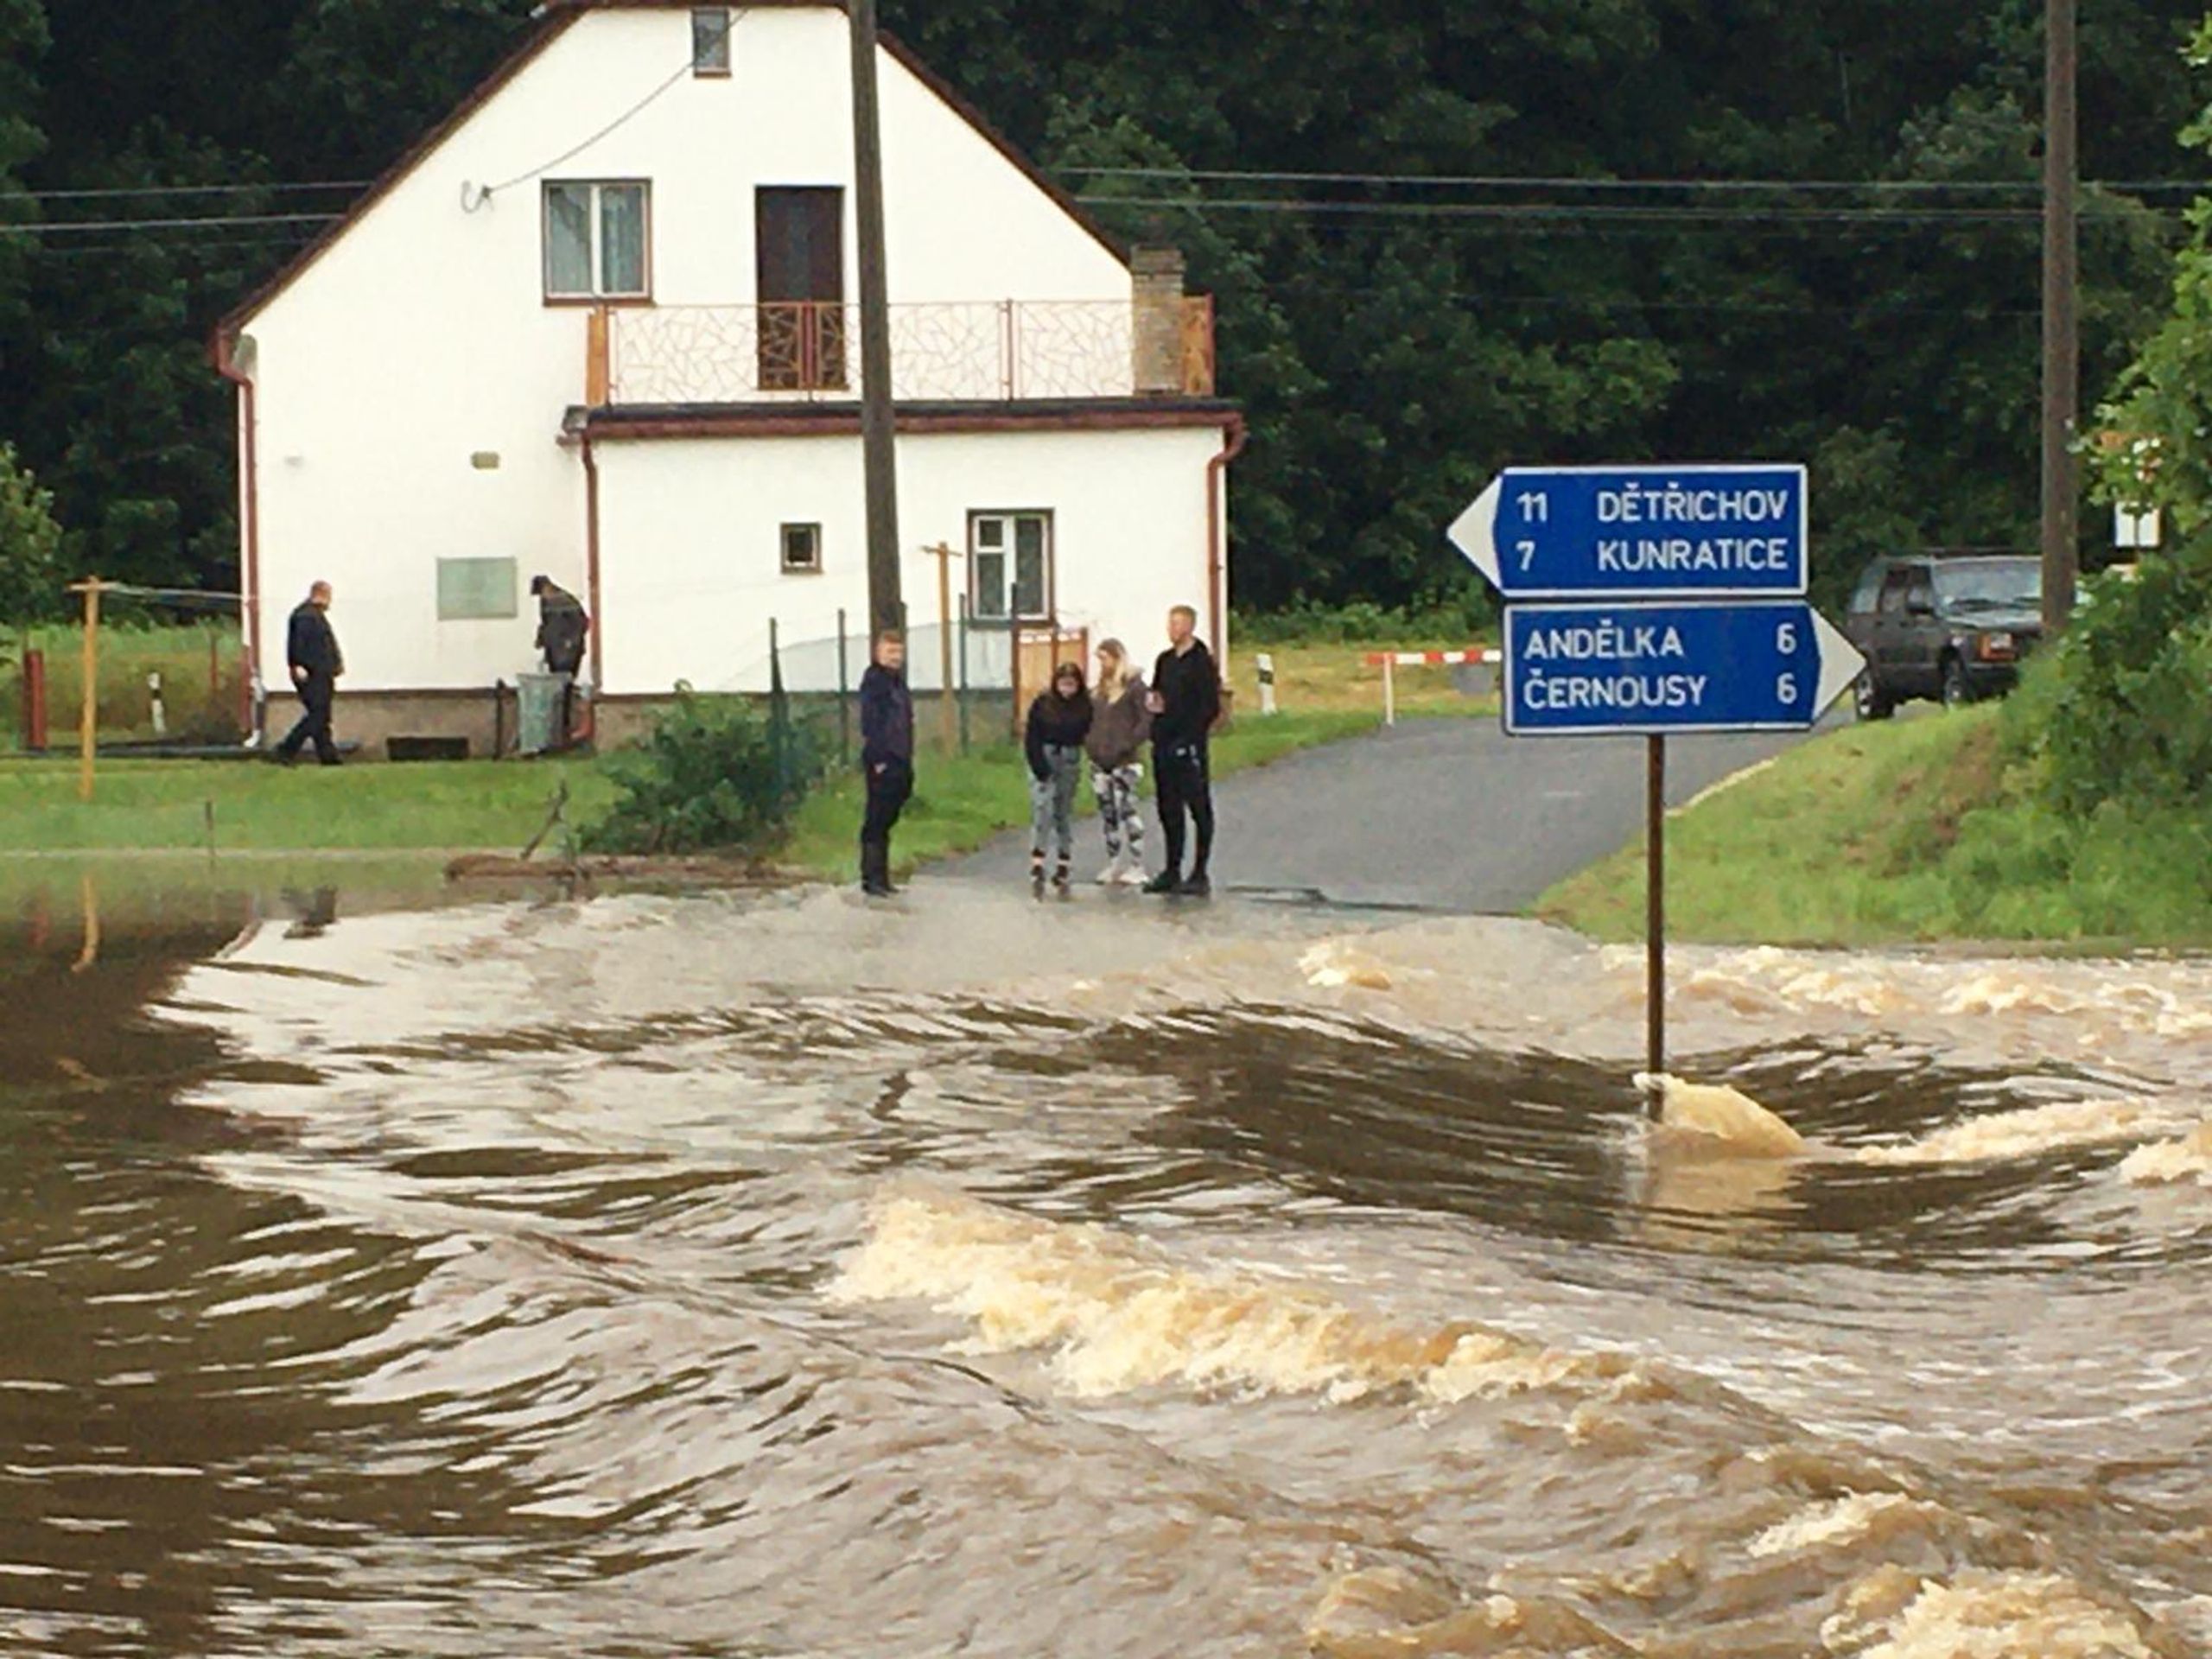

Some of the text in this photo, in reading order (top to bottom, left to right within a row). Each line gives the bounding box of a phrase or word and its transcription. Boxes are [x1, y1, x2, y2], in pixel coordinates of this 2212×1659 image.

[1516, 482, 1788, 523] 11 DĚTŘICHOV
[1516, 537, 1788, 572] 7 KUNRATICE
[1523, 619, 1797, 660] ANDĚLKA 6
[1523, 669, 1798, 709] ČERNOUSY 6
